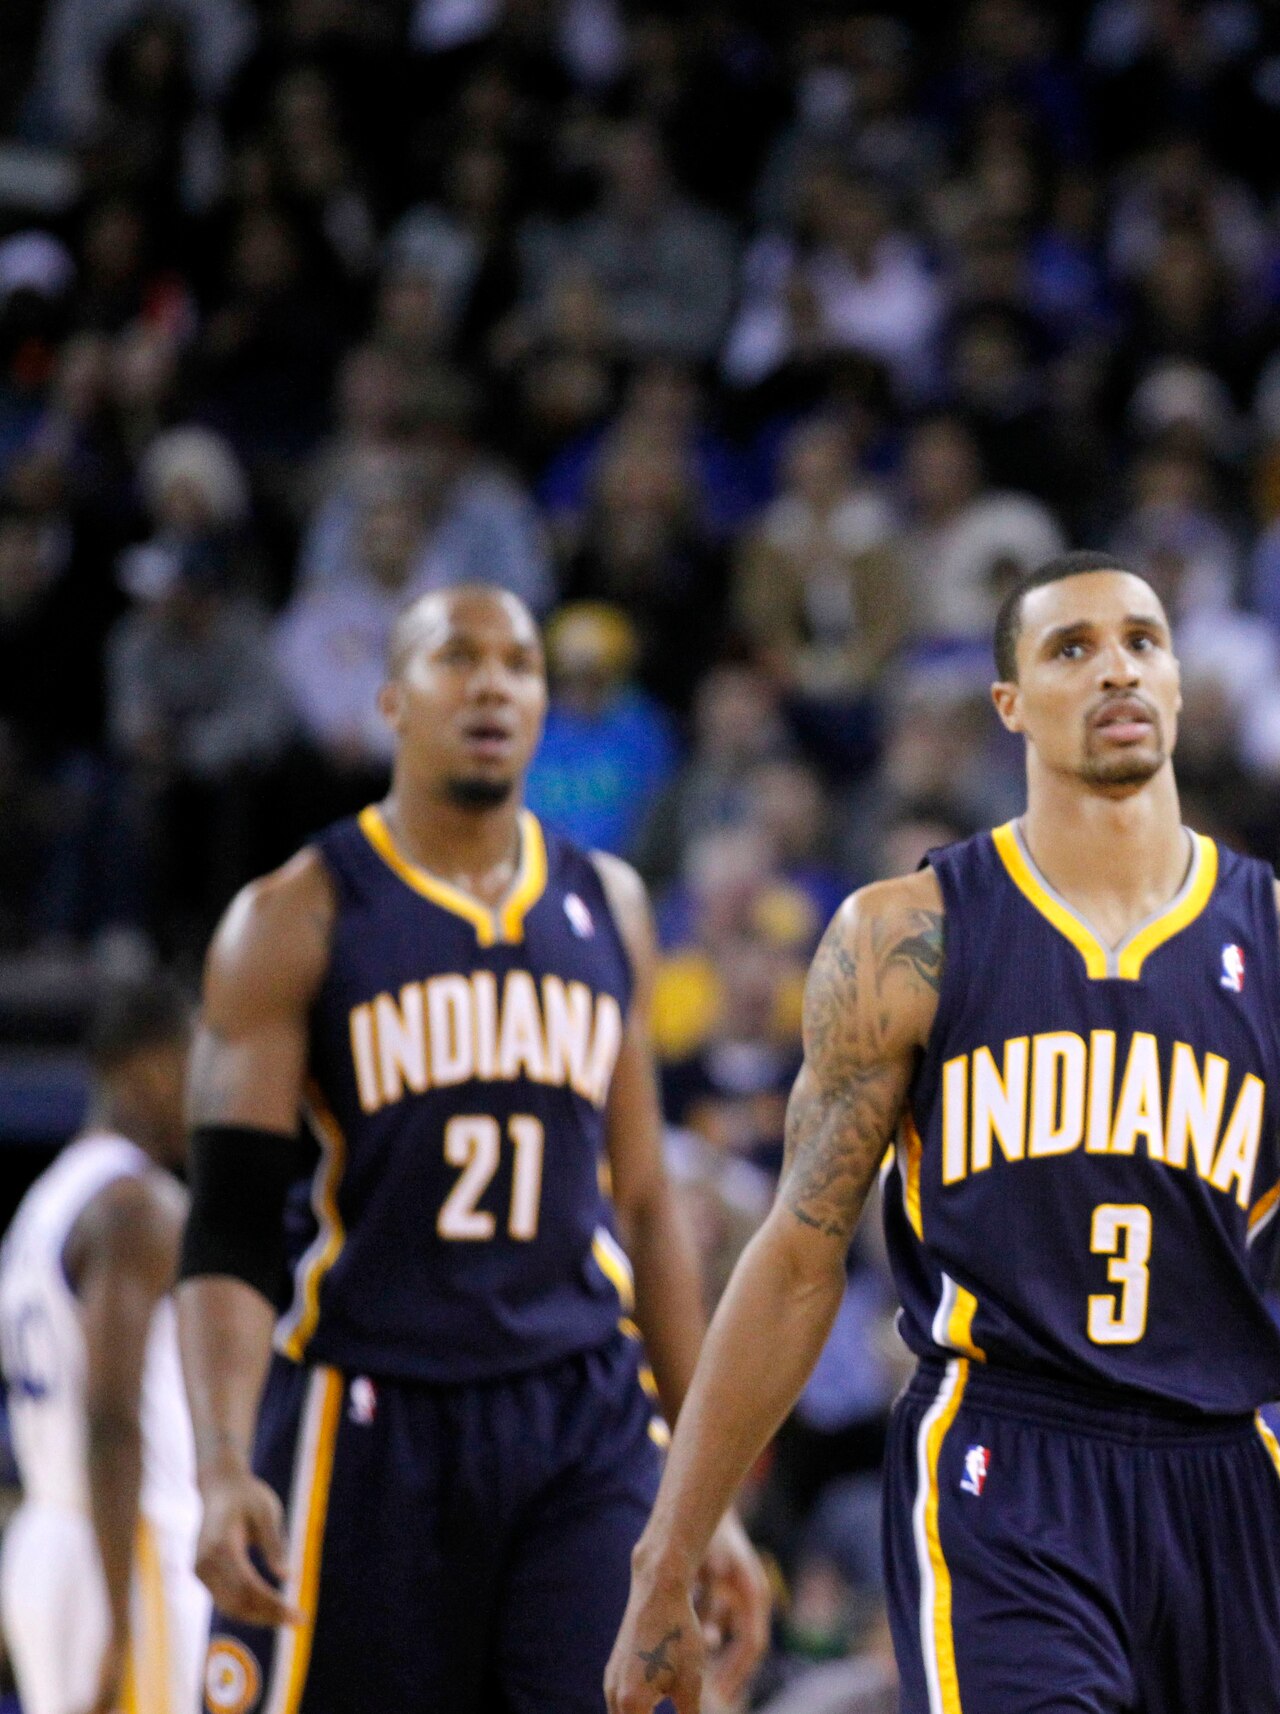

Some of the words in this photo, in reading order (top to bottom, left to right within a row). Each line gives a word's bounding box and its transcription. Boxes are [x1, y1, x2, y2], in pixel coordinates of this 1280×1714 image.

[436, 1112, 545, 1242] 21
[942, 1028, 1265, 1211] INDIANA
[1087, 1203, 1152, 1345] 3
